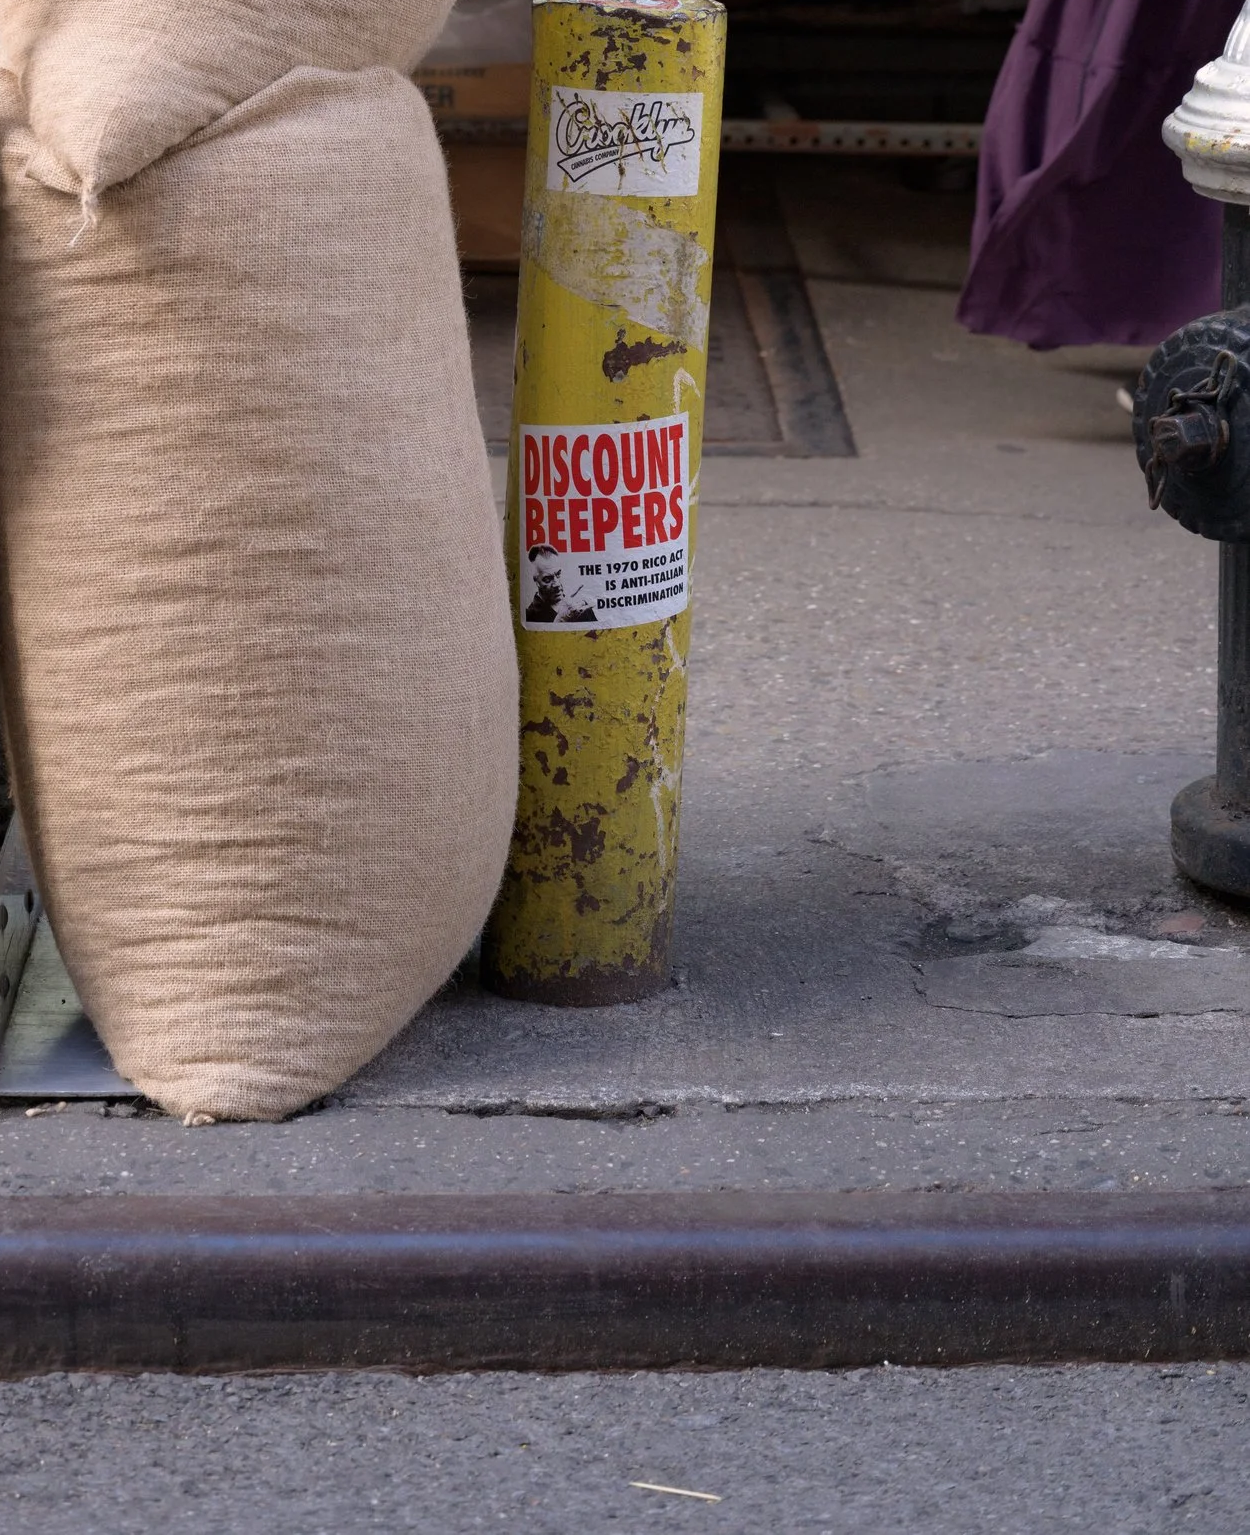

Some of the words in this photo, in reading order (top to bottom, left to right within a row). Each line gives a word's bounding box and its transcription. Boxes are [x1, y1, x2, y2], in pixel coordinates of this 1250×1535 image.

[556, 100, 696, 163] Crooklyn
[570, 156, 594, 171] CANNABIS
[594, 148, 620, 162] COMPANY
[524, 423, 684, 497] DISCOUNT
[525, 484, 684, 553] BEEPERS
[578, 564, 602, 576] THE
[606, 560, 639, 574] 1970
[642, 554, 667, 570] RICO
[669, 548, 684, 564] ACT
[605, 579, 617, 591] IS
[621, 565, 684, 590] ANTI-ITALIAN
[597, 582, 684, 610] DISCRIMINATION
